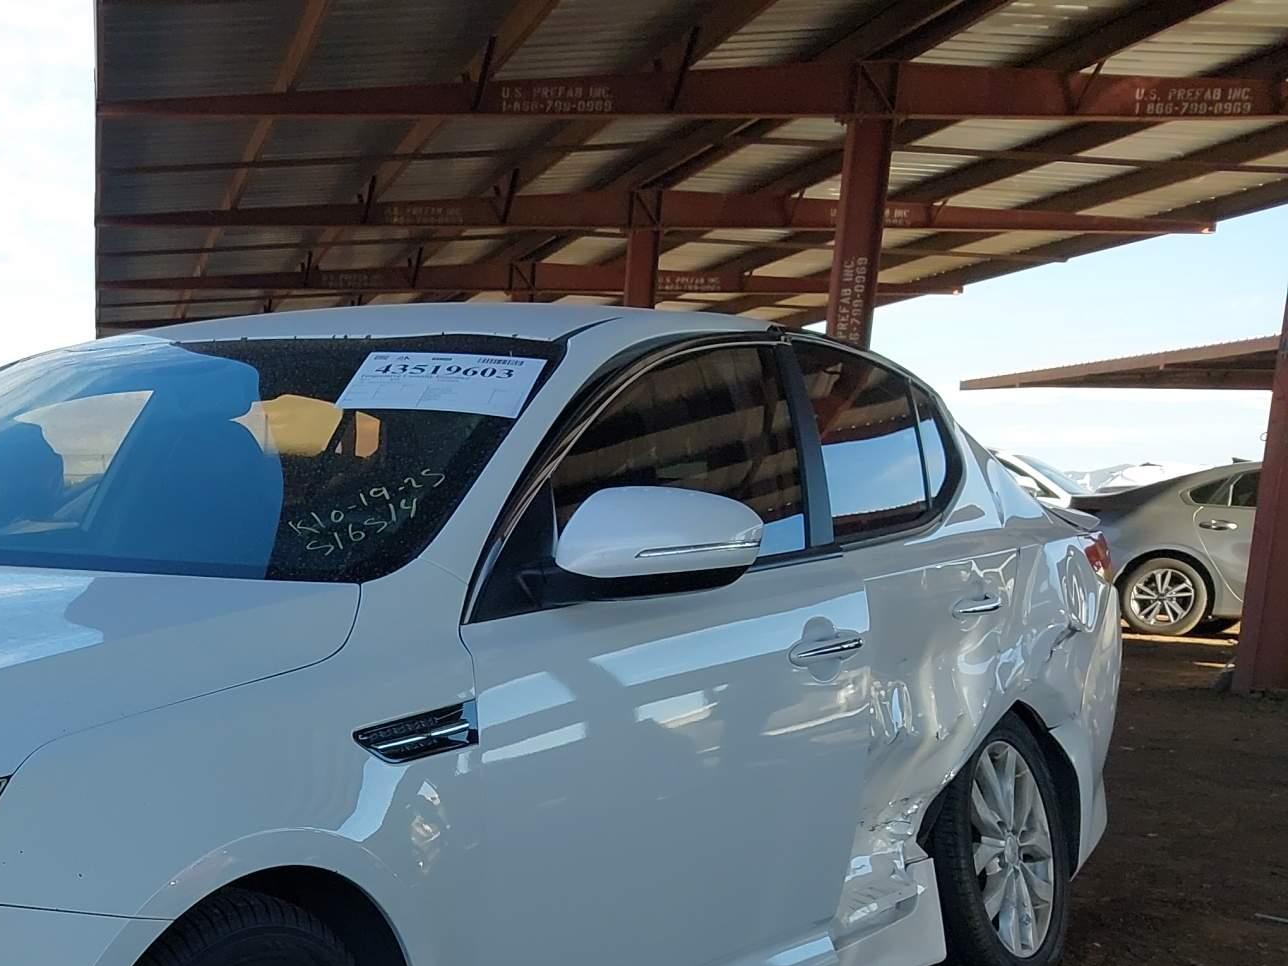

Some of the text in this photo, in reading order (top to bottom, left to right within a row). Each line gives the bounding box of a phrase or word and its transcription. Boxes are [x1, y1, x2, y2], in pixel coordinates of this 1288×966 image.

[1135, 87, 1161, 101] U.S.
[1167, 87, 1222, 101] PREFAB
[374, 363, 515, 379] 43519603
